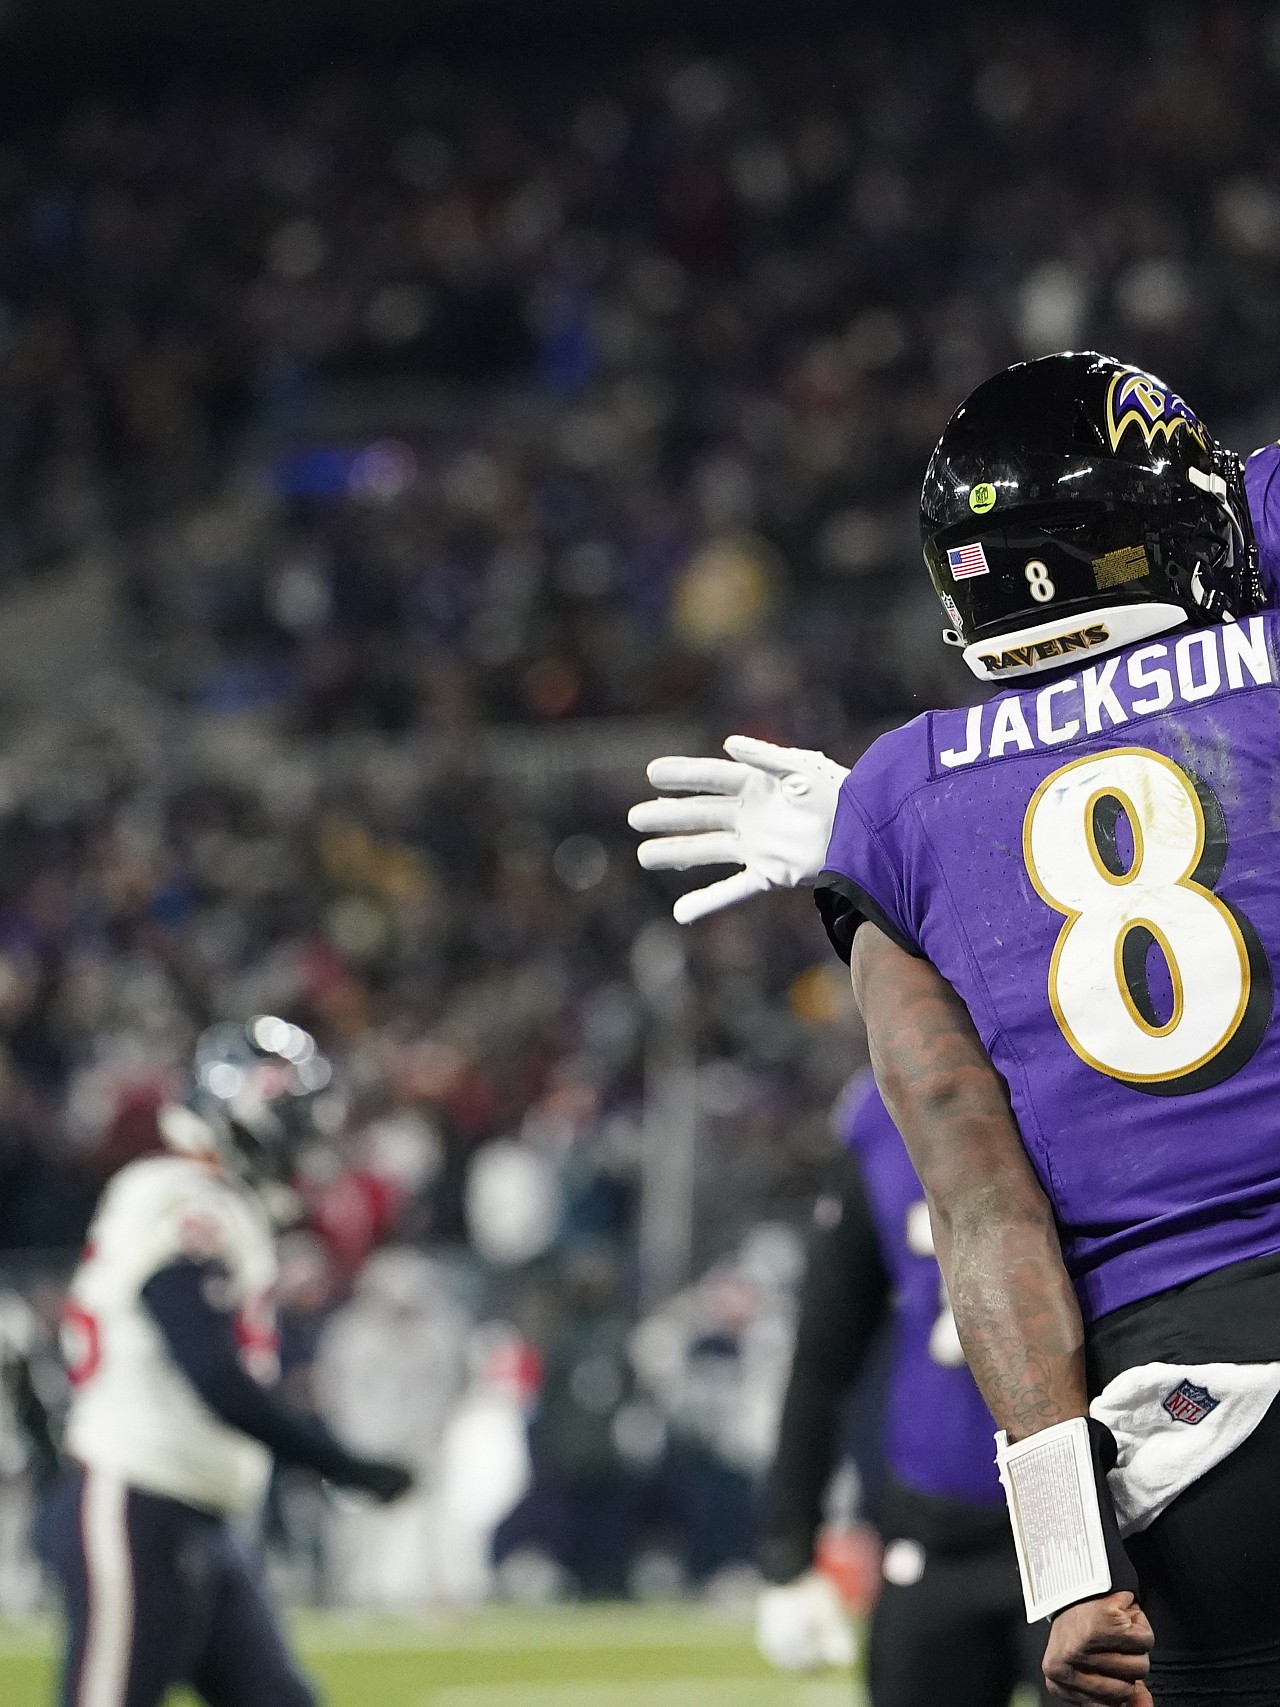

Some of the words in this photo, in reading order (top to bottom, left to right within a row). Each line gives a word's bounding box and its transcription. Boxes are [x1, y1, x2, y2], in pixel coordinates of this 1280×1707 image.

[1024, 560, 1055, 602] 8
[977, 623, 1110, 672] RAVENS
[940, 616, 1272, 769] JACKSON
[1022, 746, 1262, 1090] 8
[1167, 1391, 1203, 1422] NFL
